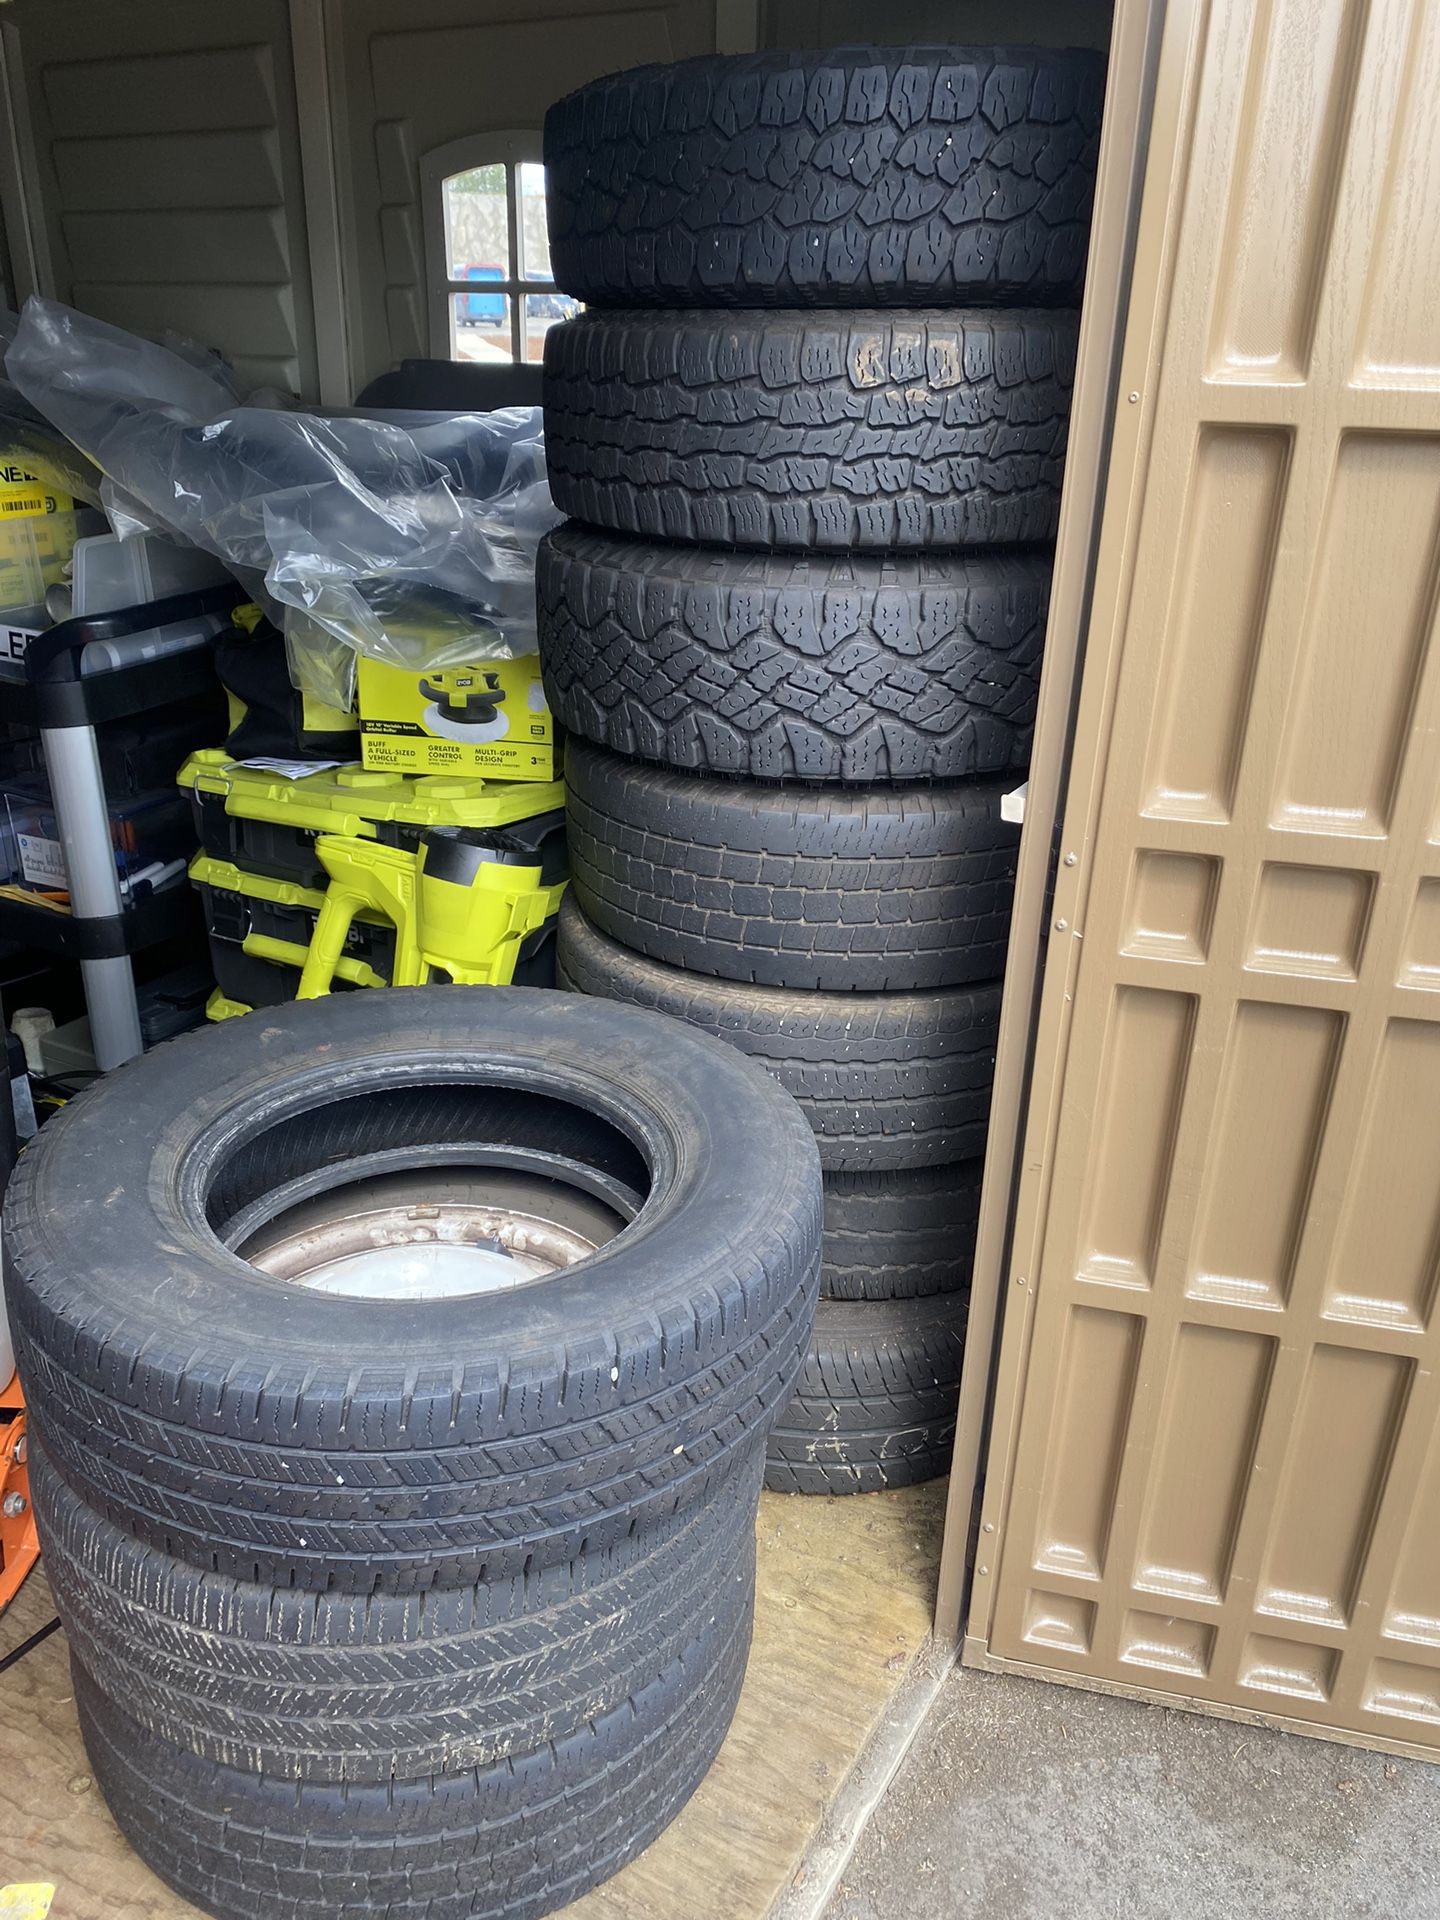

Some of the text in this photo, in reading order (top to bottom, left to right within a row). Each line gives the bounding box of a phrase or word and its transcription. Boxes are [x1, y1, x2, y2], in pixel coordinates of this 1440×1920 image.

[375, 748, 416, 757] FULL-SIZED
[428, 745, 460, 753] GREATER
[474, 749, 518, 757] MULTI-GRIP
[428, 752, 463, 760] CONTROL
[474, 755, 503, 763] DESIGN
[530, 756, 537, 765] 3
